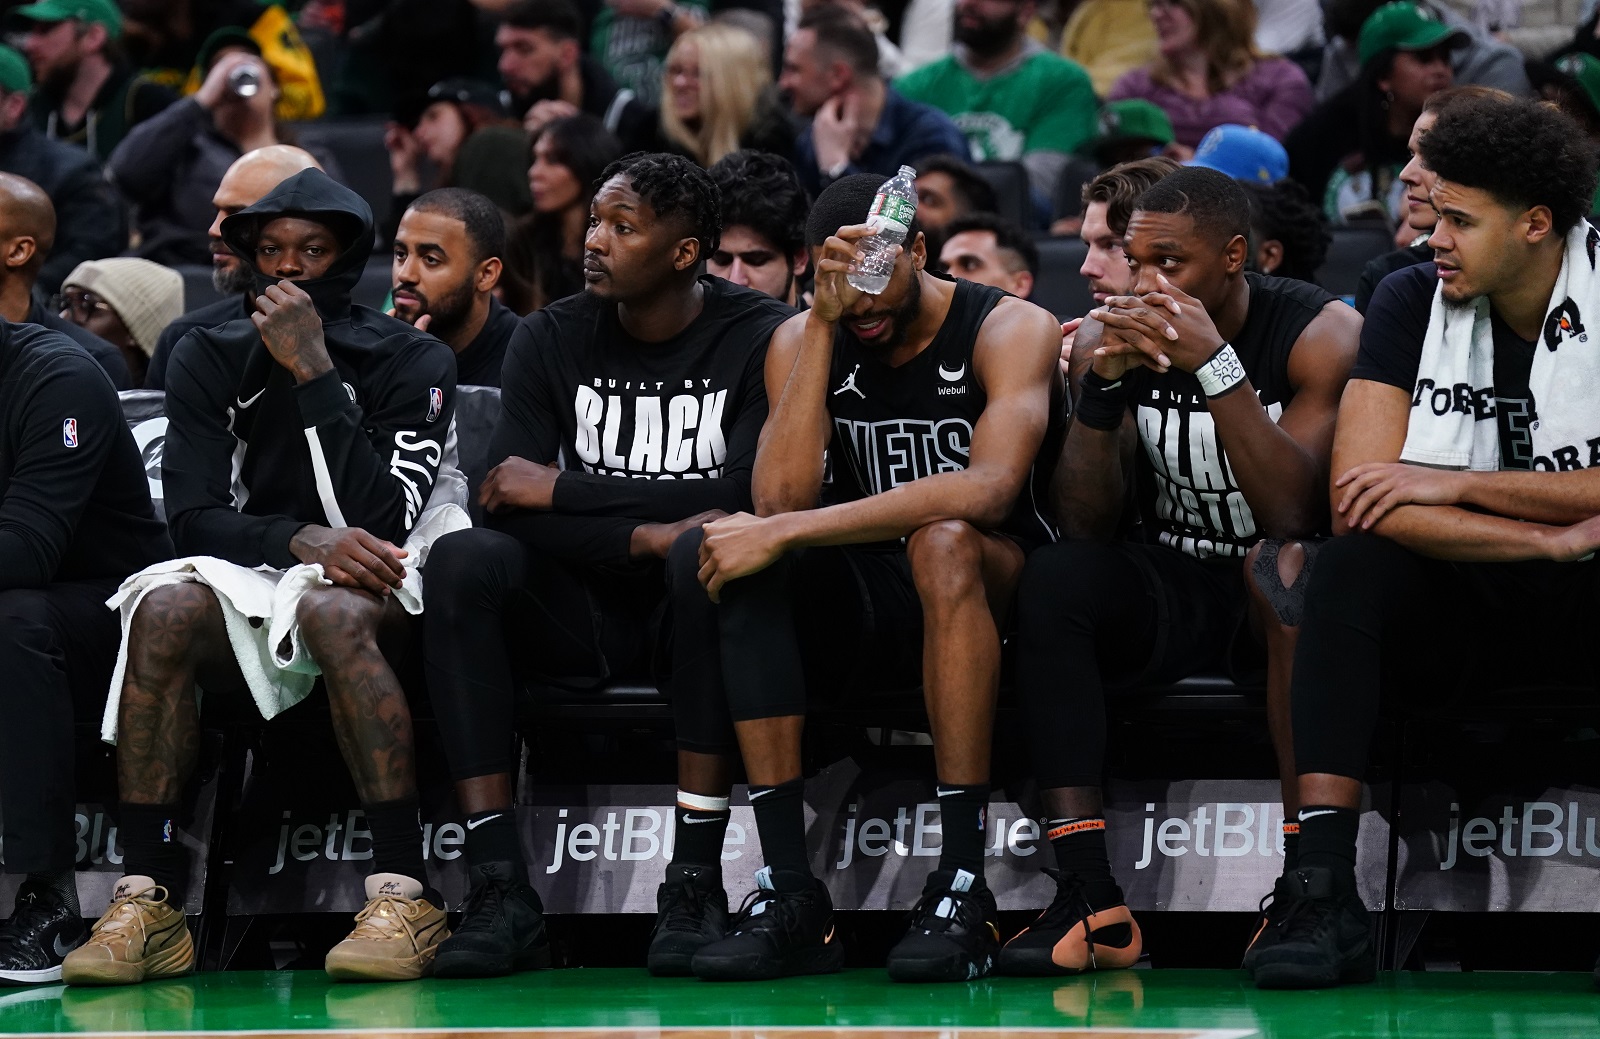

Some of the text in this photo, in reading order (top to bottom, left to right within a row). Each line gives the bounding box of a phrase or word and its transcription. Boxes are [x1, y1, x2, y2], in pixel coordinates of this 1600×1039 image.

[594, 378, 711, 390] BUILT BY
[937, 385, 966, 396] Webull
[1151, 389, 1200, 404] BIL
[575, 384, 728, 473] BLACK
[834, 417, 974, 496] NETS
[1154, 472, 1257, 538] HISTO
[269, 810, 466, 875] jetBe
[546, 808, 746, 875] jetBle
[837, 803, 1041, 870] jetBue
[1135, 803, 1286, 870] jetBl
